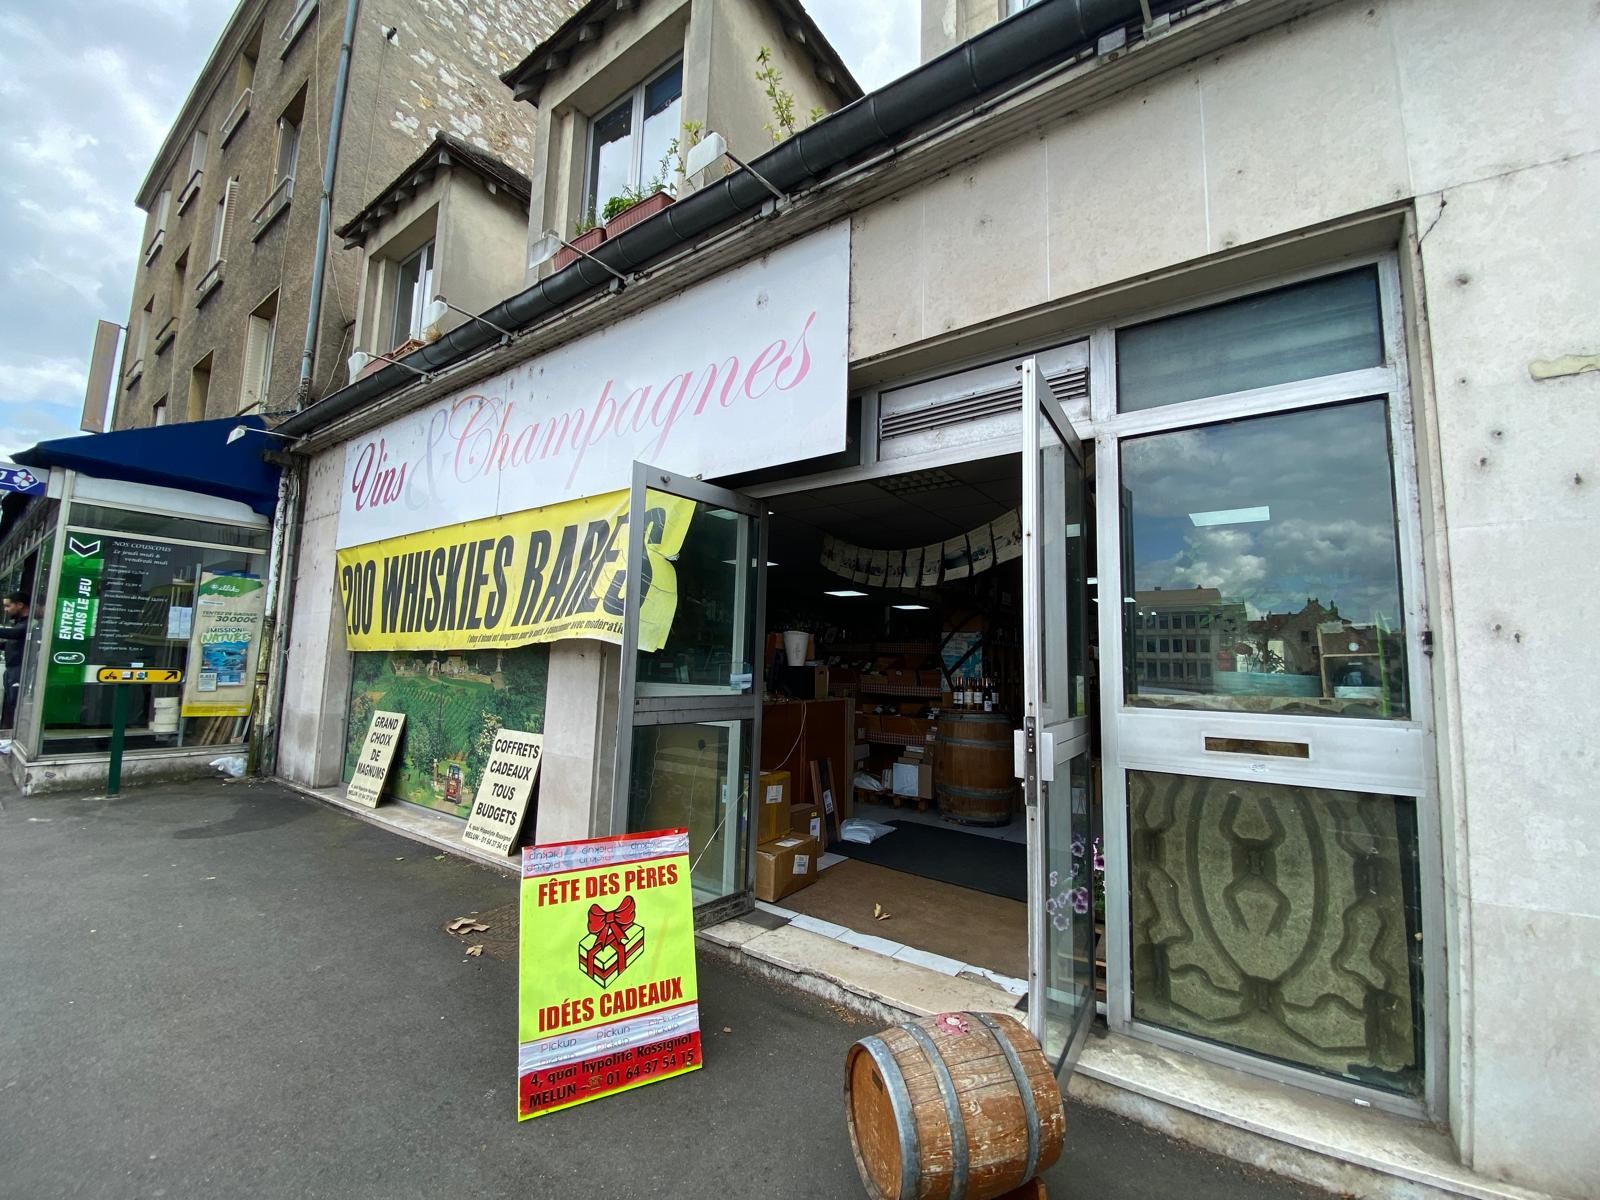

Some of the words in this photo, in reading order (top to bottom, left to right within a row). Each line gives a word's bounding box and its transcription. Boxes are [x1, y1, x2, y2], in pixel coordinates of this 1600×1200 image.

[352, 441, 408, 512] Vins
[405, 408, 454, 511] &
[448, 311, 817, 491] Champagnes
[78, 578, 92, 597] JEU
[342, 559, 376, 635] 200
[381, 534, 514, 634] WHISKIES
[77, 597, 89, 610] LE
[59, 600, 76, 640] ENTREZ
[73, 612, 88, 640] DANS
[585, 618, 623, 634] modérati
[202, 632, 252, 643] NATURE
[374, 716, 399, 730] GRAND
[370, 731, 393, 746] CHOIX
[495, 738, 540, 759] COFFRETS
[370, 749, 381, 762] DE
[356, 762, 386, 780] MAGNUMS
[490, 760, 532, 781] CADEAUX
[491, 783, 516, 801] TOUS
[476, 802, 517, 826] BUDGETS
[538, 877, 580, 907] FÊTE
[586, 873, 620, 899] DES
[625, 864, 678, 892] PÈRES
[538, 997, 594, 1032] IDÉES
[599, 976, 683, 1018] CADEAUX
[540, 1038, 577, 1053] Pickup
[597, 1025, 631, 1040] Pickup
[531, 1074, 543, 1088] 4,
[547, 1064, 577, 1085] quai
[637, 1033, 692, 1058] Rossignol
[529, 1082, 577, 1108] MELUN
[607, 1070, 620, 1085] 01
[626, 1064, 640, 1079] 64
[644, 1059, 658, 1074] 37
[663, 1053, 676, 1069] 54
[680, 1048, 694, 1064] 15
